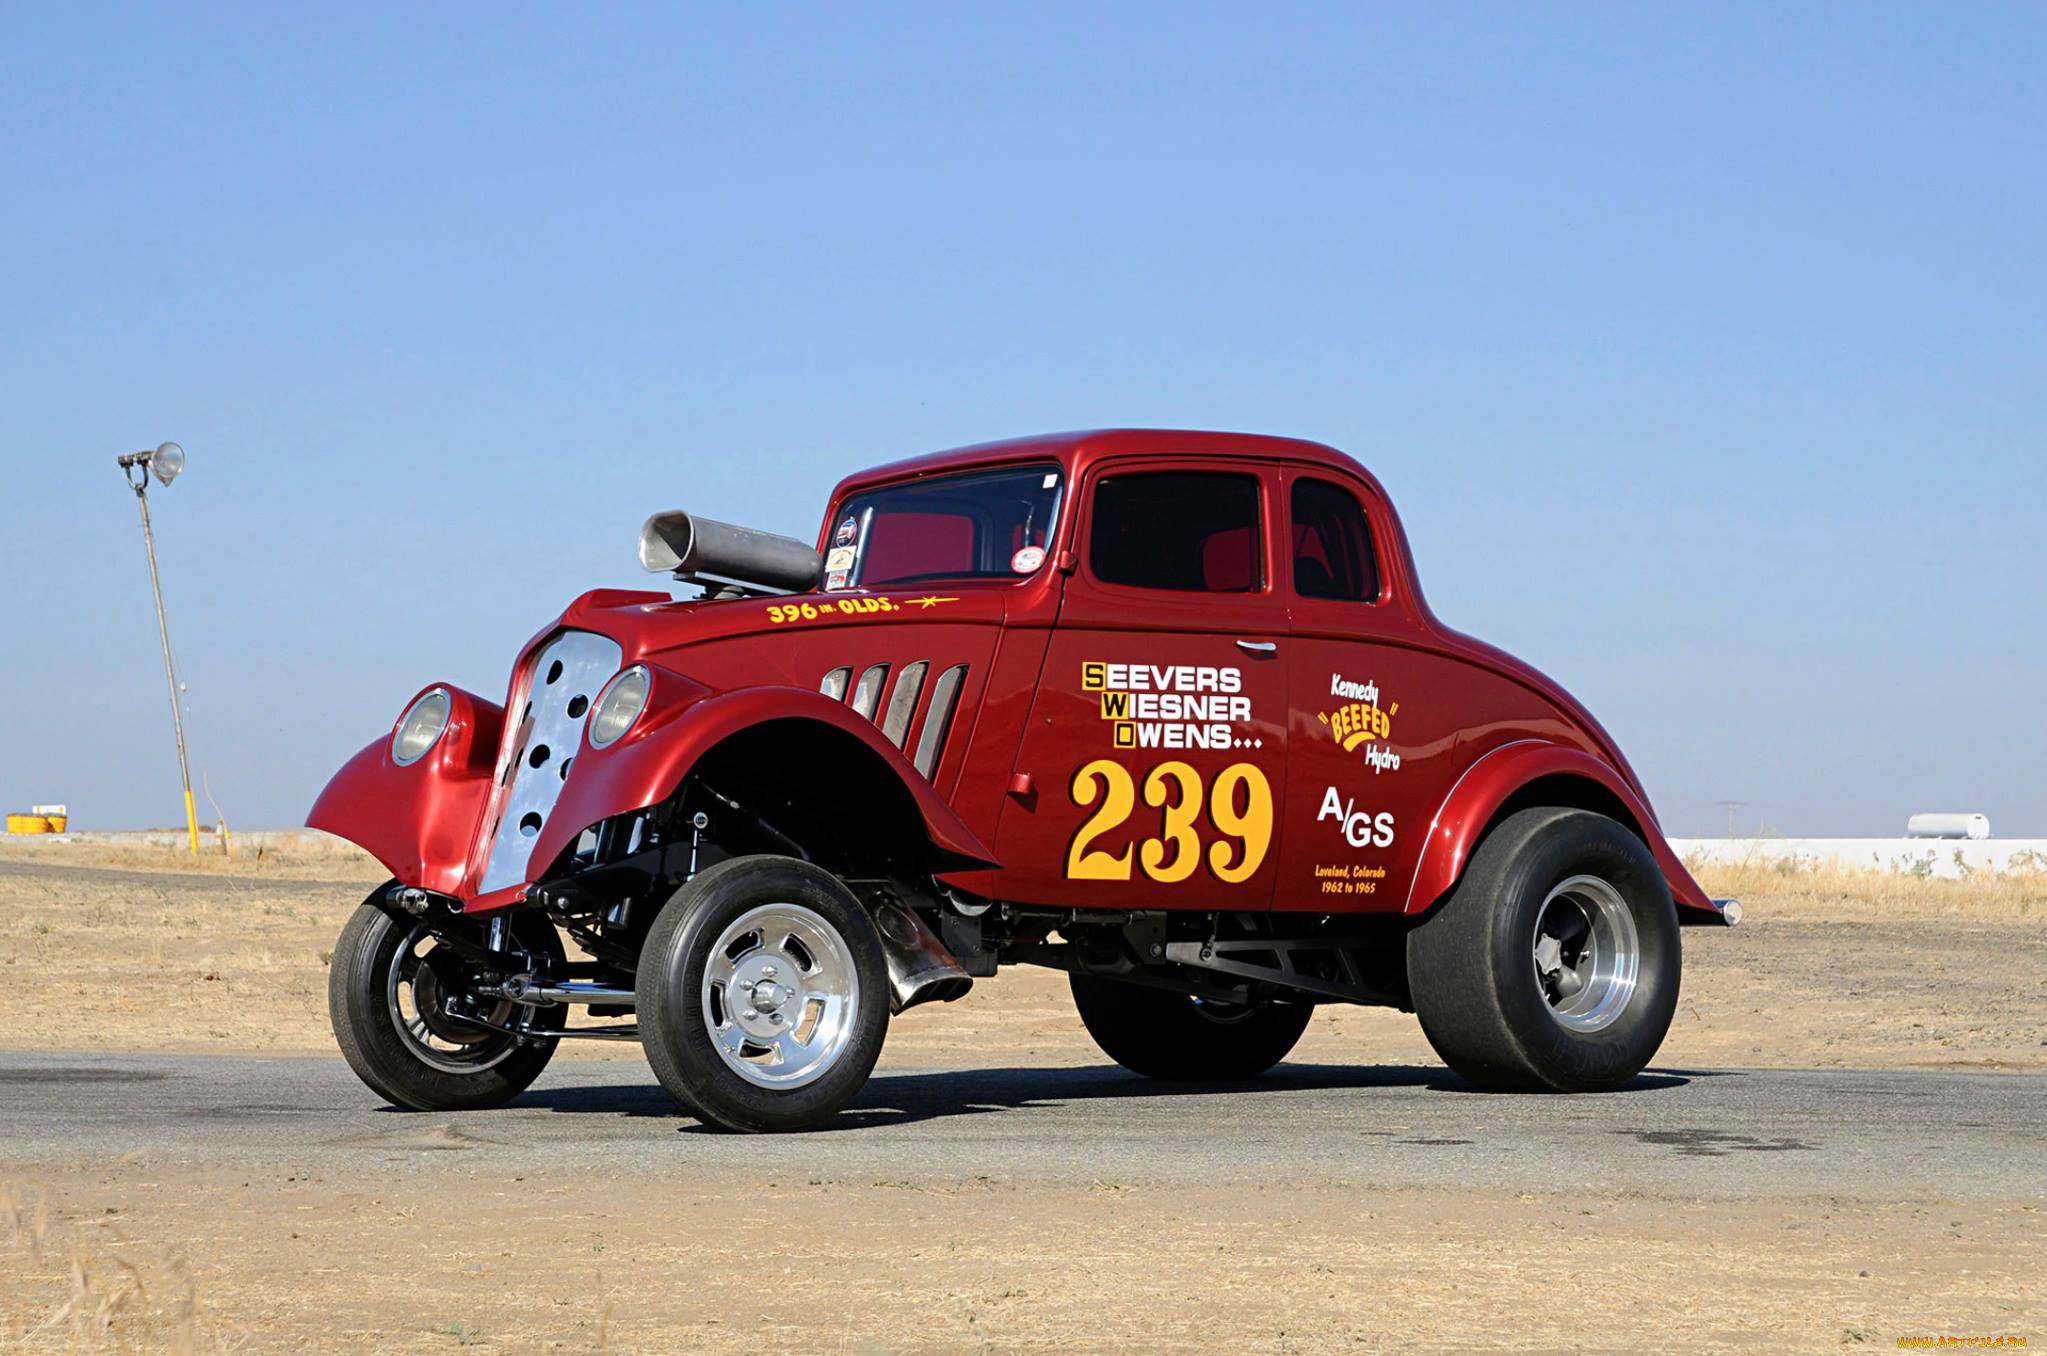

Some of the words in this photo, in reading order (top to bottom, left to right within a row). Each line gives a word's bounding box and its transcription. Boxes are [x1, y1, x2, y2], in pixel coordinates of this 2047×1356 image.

[766, 602, 818, 624] 396
[838, 596, 900, 615] OLDS.
[1083, 662, 1242, 693] SEEVERS
[1330, 673, 1380, 708] Kennedy
[1102, 692, 1252, 721] WIESNER
[1364, 743, 1401, 775] Hydro
[1064, 759, 1274, 884] 239
[1314, 864, 1351, 878] Loveland,
[1352, 865, 1386, 878] Colorado
[1321, 882, 1343, 894] 1962
[1344, 882, 1353, 894] to
[1354, 882, 1376, 894] 1965
